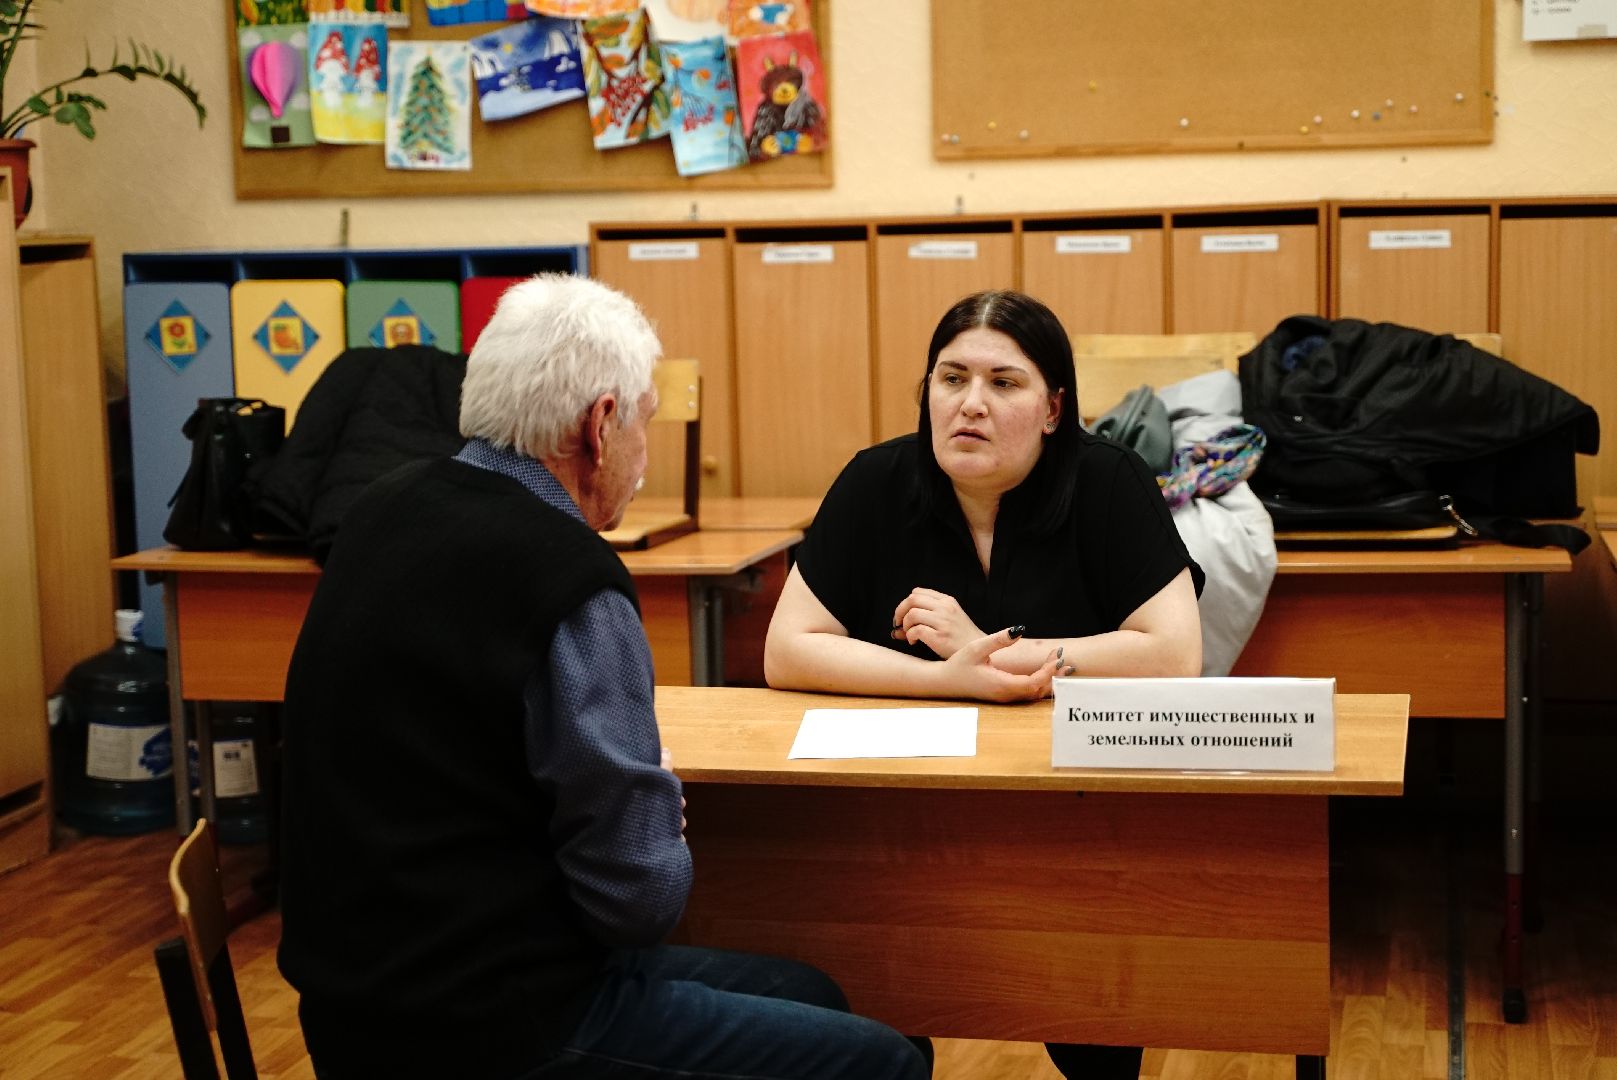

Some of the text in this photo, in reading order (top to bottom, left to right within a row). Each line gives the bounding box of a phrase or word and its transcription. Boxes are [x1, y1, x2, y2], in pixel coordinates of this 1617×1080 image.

[1067, 707, 1315, 727] Комитет имущественных и
[1087, 732, 1294, 748] земельных отношений
